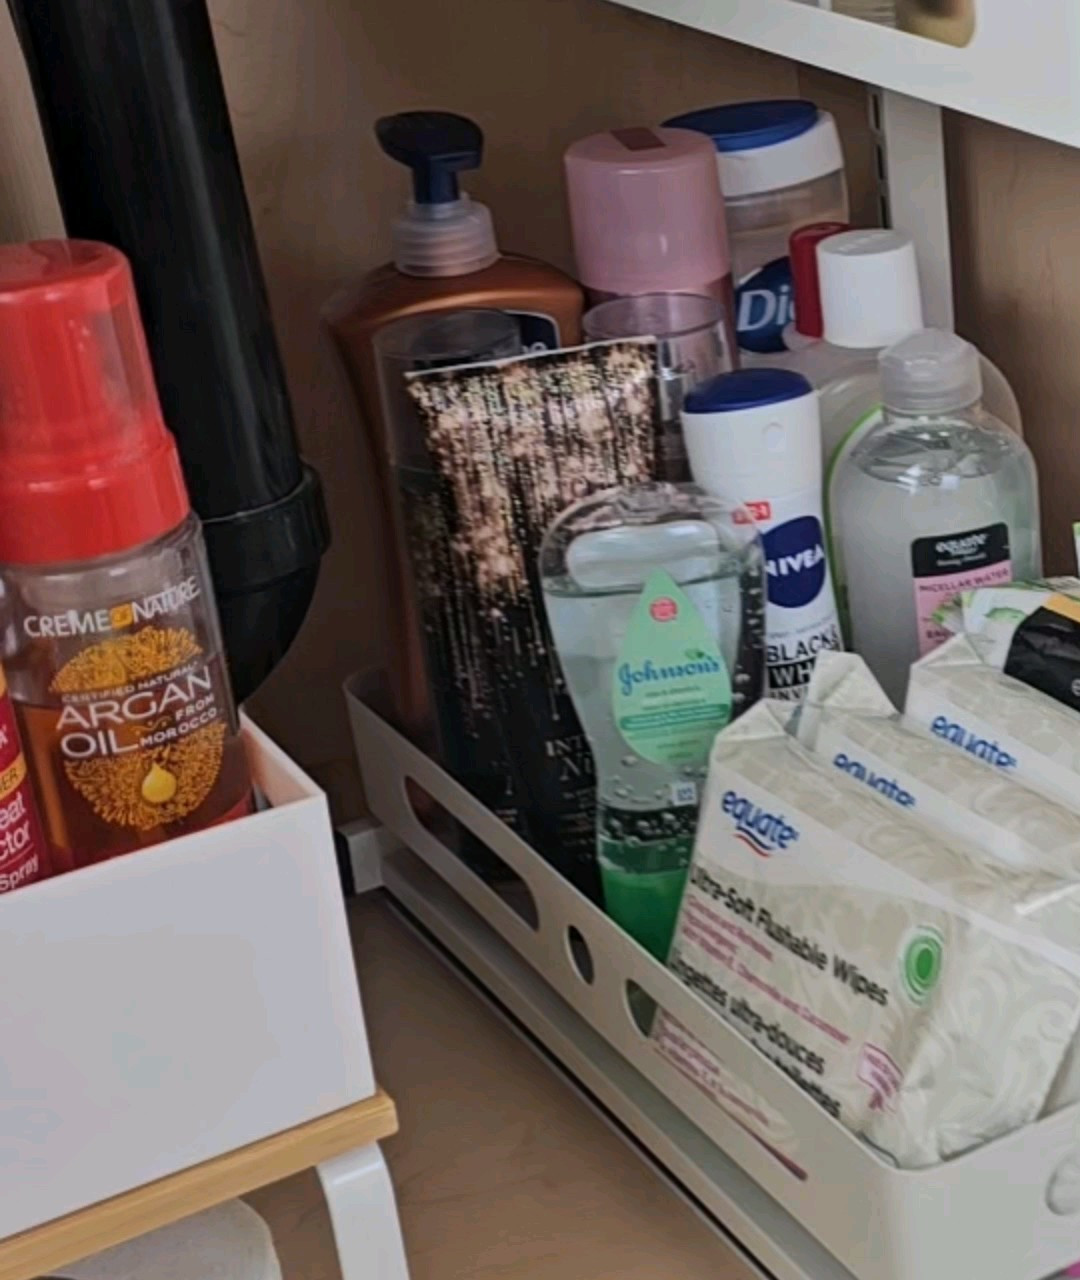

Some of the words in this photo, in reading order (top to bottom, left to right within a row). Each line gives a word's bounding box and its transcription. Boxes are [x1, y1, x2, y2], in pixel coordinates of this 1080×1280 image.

[737, 285, 795, 332] Di
[766, 544, 824, 577] NIVEA
[24, 609, 110, 637] CREME
[131, 576, 200, 622] NATURE
[62, 684, 134, 703] CERTIFIED
[619, 655, 720, 696] Johnson's
[56, 665, 211, 732] ARGAN
[175, 693, 214, 722] FROM
[61, 730, 139, 759] OIL
[140, 707, 217, 748] MOROCCO
[0, 792, 26, 830] eat
[721, 790, 797, 849] equate
[756, 909, 828, 970] Flushable
[832, 957, 889, 1007] Wipes
